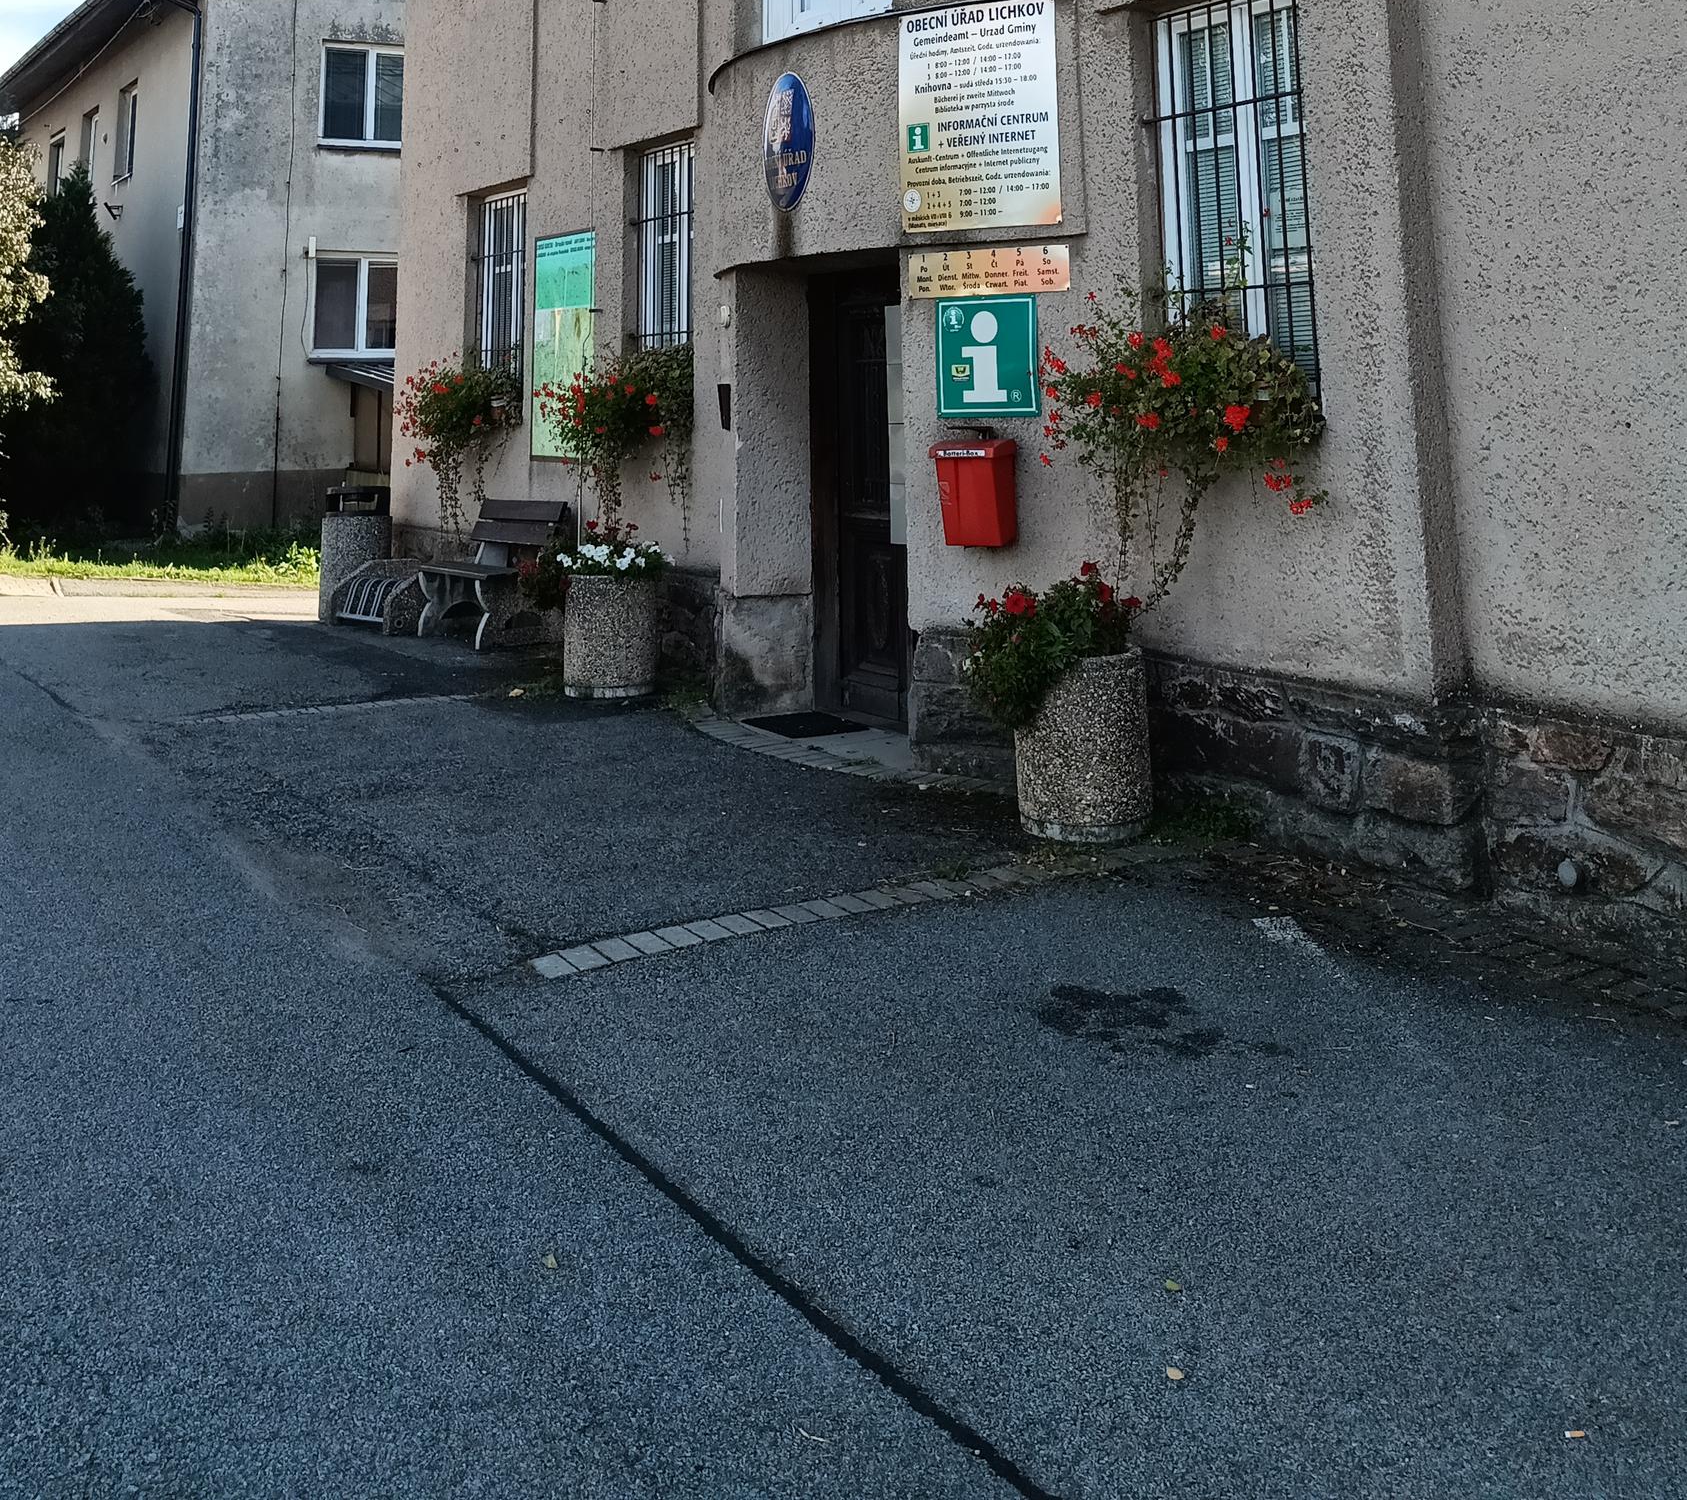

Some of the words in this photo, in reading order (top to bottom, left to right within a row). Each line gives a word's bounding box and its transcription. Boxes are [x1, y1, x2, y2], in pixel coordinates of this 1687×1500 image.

[907, 11, 947, 33] OBECNÍ
[952, 8, 984, 26] ÚŘAD
[989, 2, 1044, 21] LICHKOV
[914, 31, 968, 47] Gemeindeamt
[980, 25, 1004, 37] Urzad
[1008, 23, 1036, 34] Gminy
[915, 82, 951, 94] Knihovna
[938, 113, 997, 132] INFORMAČNÍ
[1001, 112, 1048, 126] CENTRUM
[947, 132, 987, 148] VEŘEJNÝ
[989, 130, 1036, 144] INTERNET
[782, 149, 807, 166] ÚŘAD
[916, 166, 938, 174] Centrum
[984, 159, 1008, 167] Internet
[980, 197, 996, 205] 12:00
[943, 253, 947, 261] 2
[967, 251, 971, 259] 3
[991, 250, 995, 258] 4
[1017, 248, 1021, 256] 5
[1041, 278, 1055, 286] Sob.
